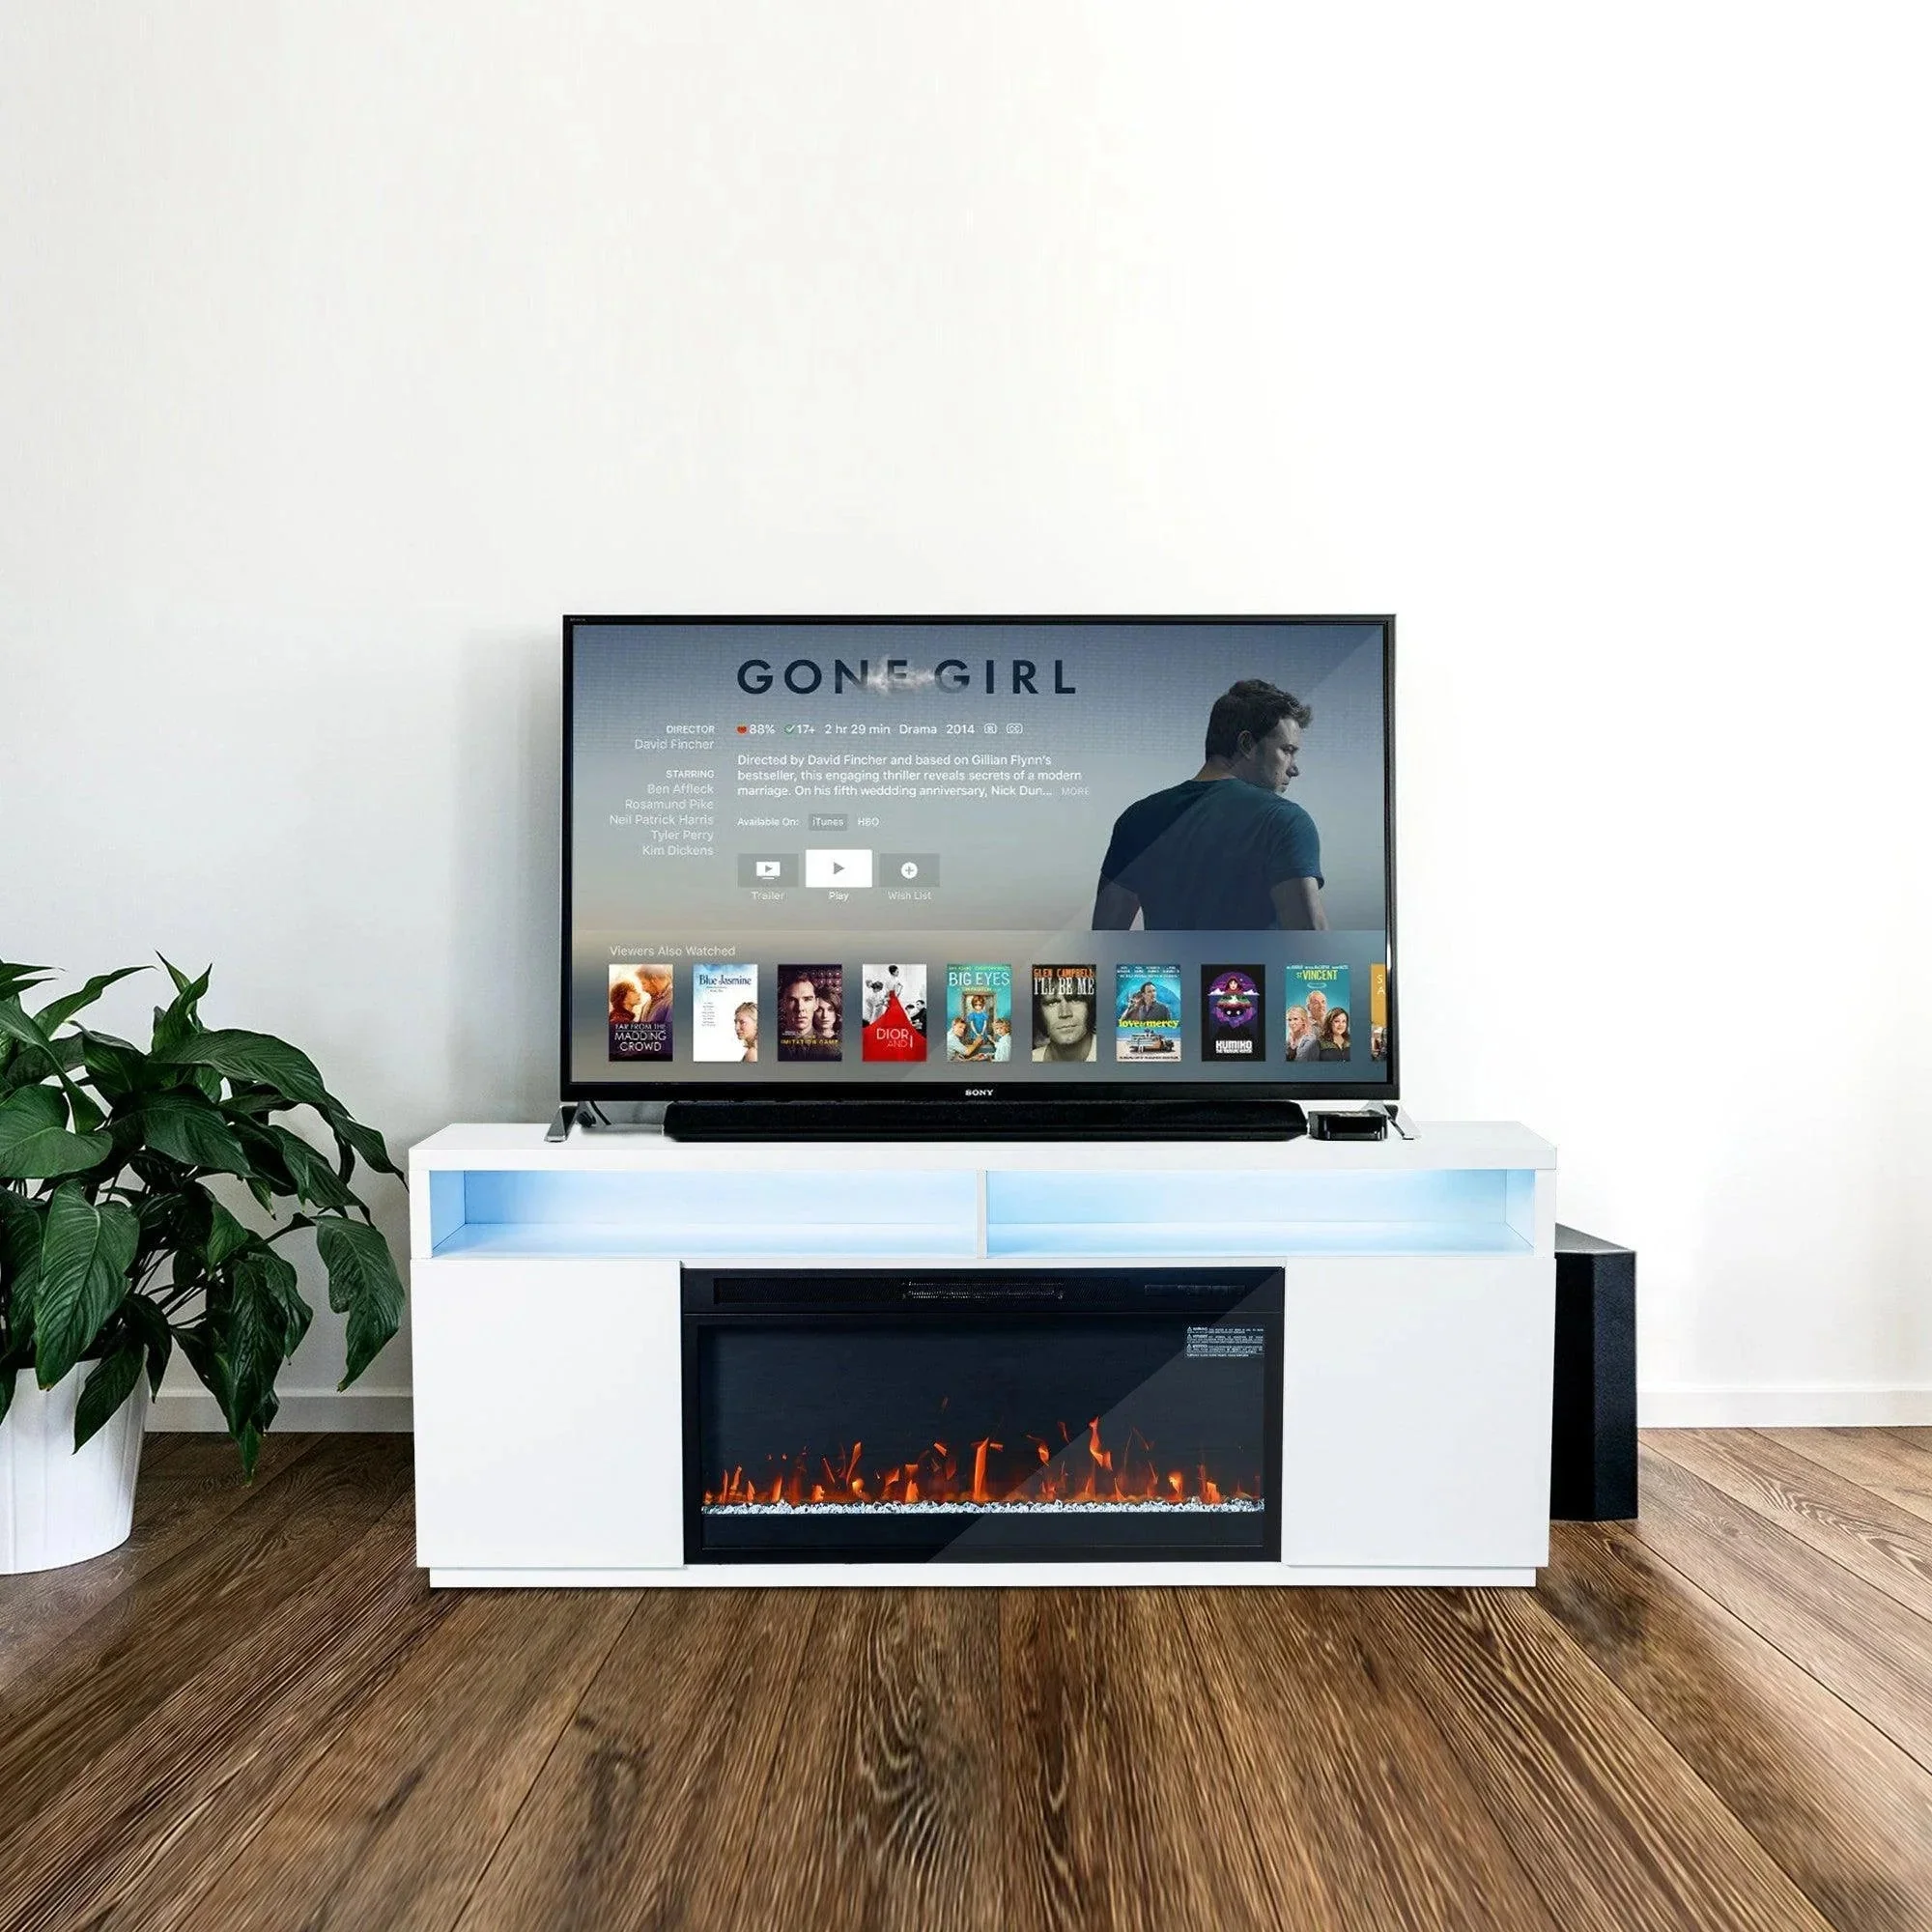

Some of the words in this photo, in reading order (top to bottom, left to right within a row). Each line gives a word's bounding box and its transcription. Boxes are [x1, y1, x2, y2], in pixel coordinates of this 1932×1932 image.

[737, 659, 908, 695] GONE
[934, 659, 1076, 695] GIRL
[666, 724, 715, 734] DIRECTOR
[749, 724, 776, 734] 88%
[797, 724, 815, 734] 17+
[824, 724, 832, 734] 2
[836, 724, 848, 734] hr
[850, 724, 867, 734] 29
[869, 724, 891, 734] min
[898, 724, 937, 734] Drama
[946, 724, 976, 734] 2014
[635, 738, 668, 750] David
[670, 738, 715, 750] Fincher
[737, 754, 787, 766] Directed
[790, 754, 806, 768] by
[808, 754, 840, 766] David
[843, 754, 887, 766] Fincher
[891, 754, 912, 766] and
[915, 754, 951, 766] based
[953, 756, 969, 765] on
[971, 754, 1008, 765] Gillian
[1010, 754, 1052, 767] Flynn's
[666, 770, 715, 779] STARRING
[737, 770, 798, 781] bestseller,
[801, 770, 822, 781] this
[826, 772, 880, 782] engaging
[883, 770, 920, 781] thriller
[923, 770, 965, 781] reveals
[968, 771, 1010, 781] secrets
[1012, 770, 1025, 781] of
[1037, 770, 1083, 781] modern
[647, 783, 669, 794] Ben
[673, 783, 715, 794] Affleck
[737, 785, 792, 797] marriage.
[794, 785, 811, 796] On
[814, 785, 831, 796] his
[834, 785, 858, 796] fifth
[920, 785, 988, 798] anniversary,
[991, 785, 1015, 796] Nick
[1019, 785, 1052, 796] Dun...
[1062, 786, 1090, 796] MORE
[625, 799, 687, 810] Rosamund
[689, 799, 715, 810] Pike
[609, 814, 633, 825] Neil
[635, 814, 675, 825] Patrick
[679, 814, 715, 825] Harris
[737, 817, 780, 827] Available
[781, 817, 800, 827] On:
[812, 817, 844, 827] iTunes
[857, 817, 880, 827] HBO
[651, 830, 678, 842] Tyler
[682, 830, 715, 842] Perry
[642, 844, 665, 856] Kim
[668, 844, 715, 856] Dickens
[751, 891, 785, 900] Trailer
[828, 891, 850, 902] Play
[888, 891, 911, 900] Wish
[914, 891, 932, 900] List
[610, 946, 655, 956] Viewers
[658, 946, 682, 956] Also
[685, 946, 736, 956] Watched
[699, 974, 718, 985] Blue
[718, 974, 752, 985] Jasmine
[949, 971, 972, 985] BIG
[976, 971, 1010, 985] EYES
[1302, 969, 1339, 980] VINCENT
[1034, 978, 1055, 996] I'LL
[1058, 978, 1073, 995] BE
[1077, 978, 1095, 995] ME
[614, 1031, 667, 1041] MADDING
[876, 1028, 909, 1040] DIOR
[619, 1041, 662, 1052] CROWD
